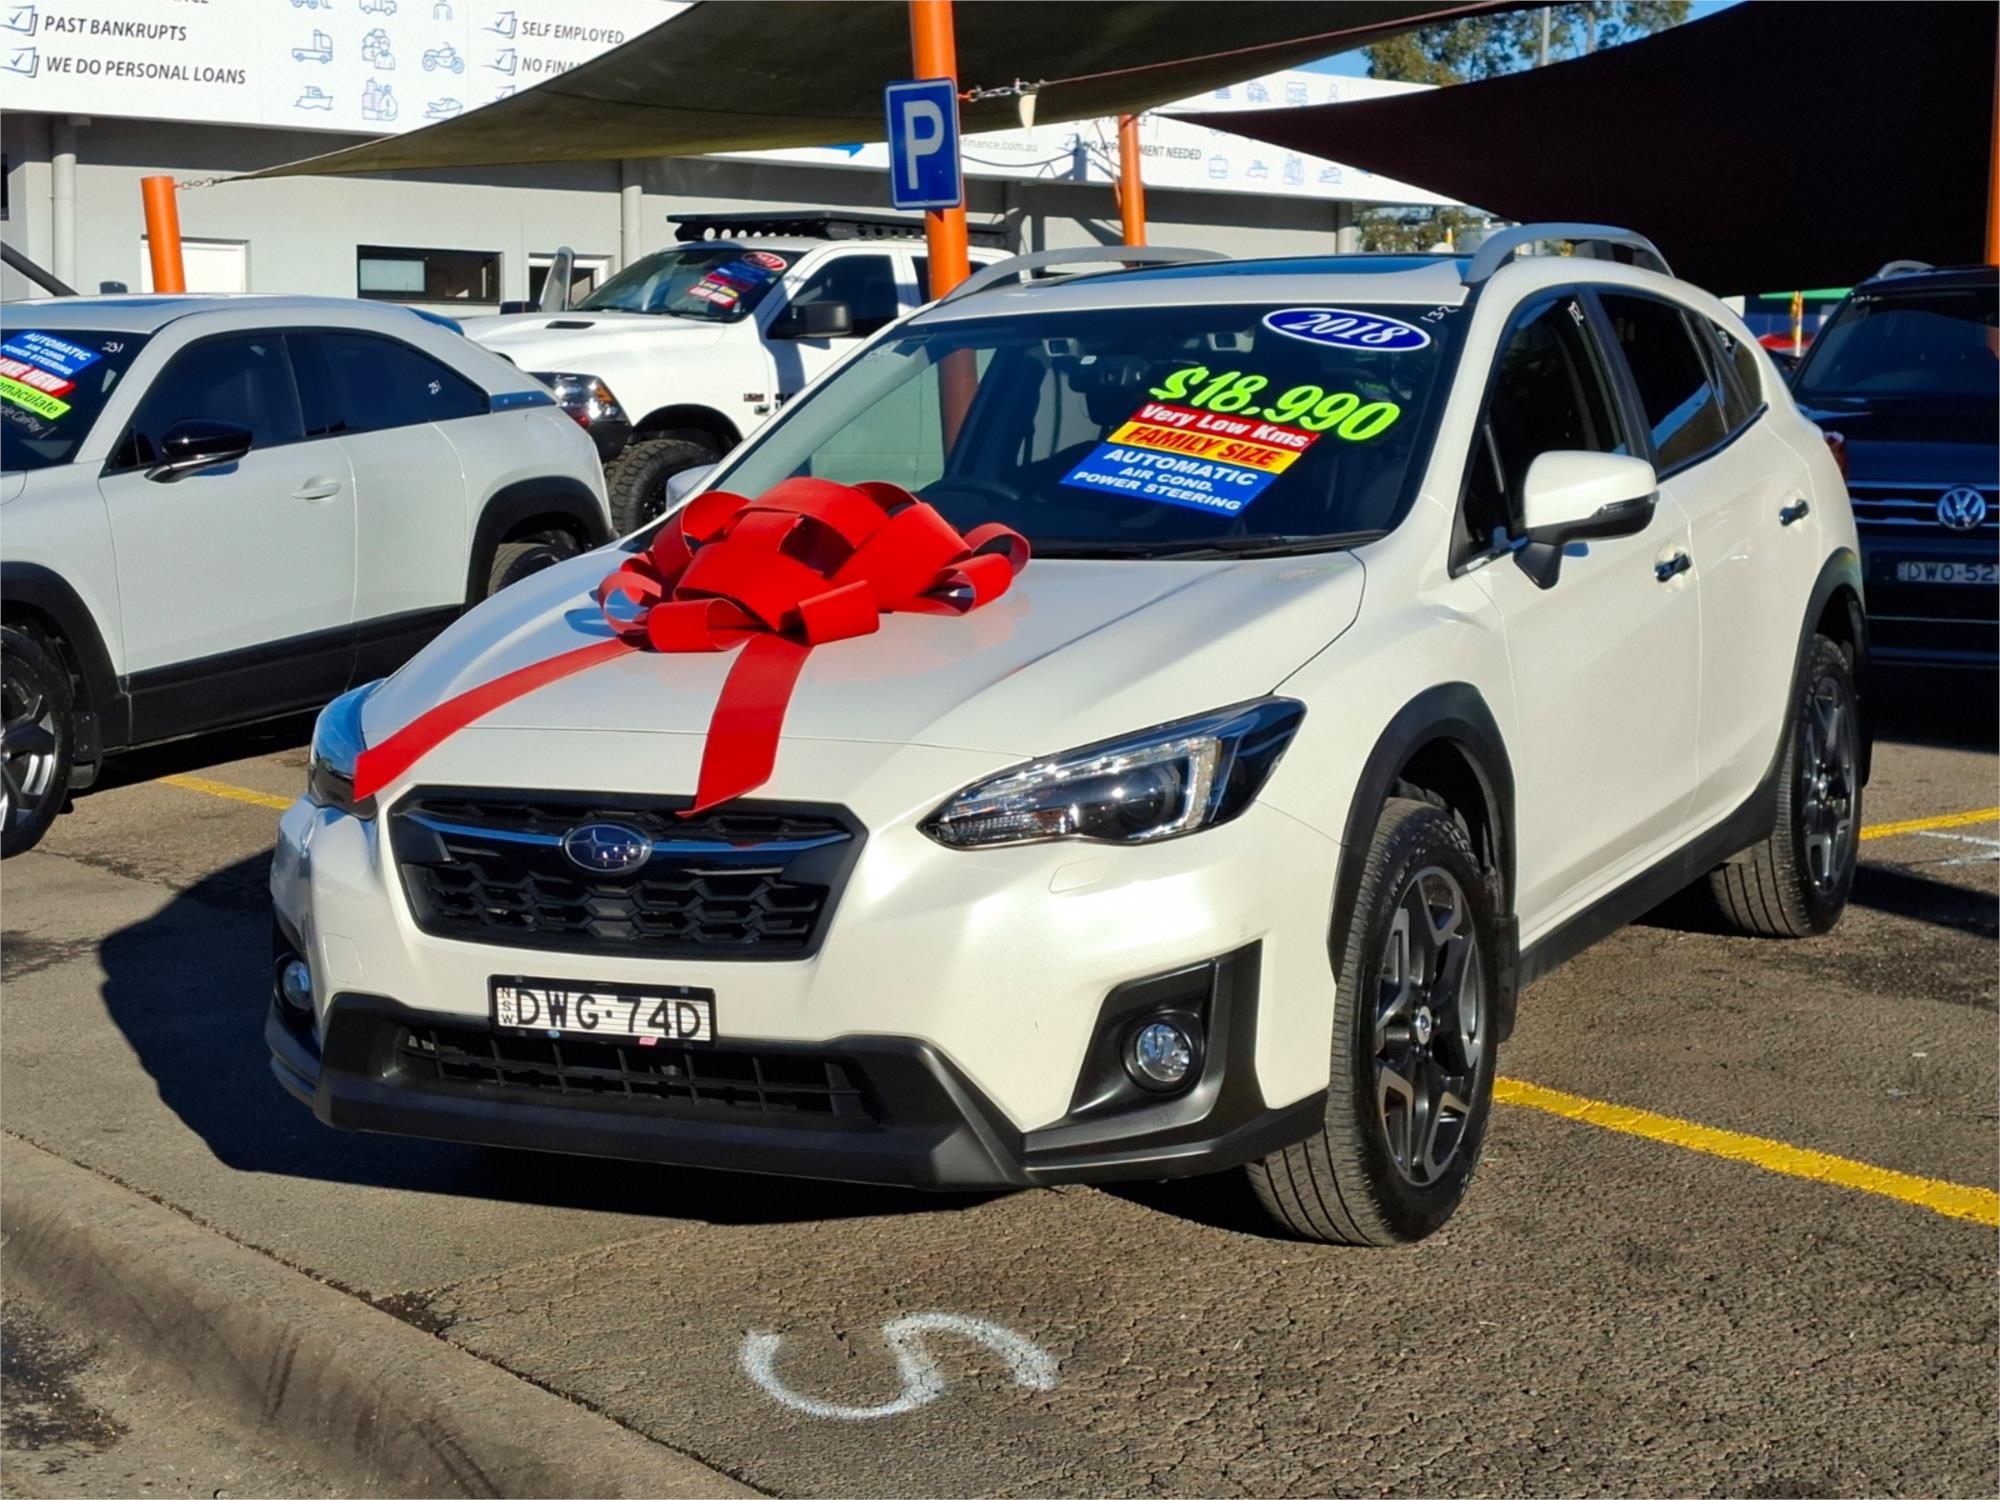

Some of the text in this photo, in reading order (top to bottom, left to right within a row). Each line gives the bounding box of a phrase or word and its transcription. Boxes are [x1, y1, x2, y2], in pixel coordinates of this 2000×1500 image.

[44, 15, 187, 41] PAST BANKRUPTS
[521, 21, 624, 44] SELF EMPLOYED
[46, 56, 246, 85] WE DO PERSONAL LOANS
[522, 57, 581, 74] NO FINA
[904, 100, 943, 190] P
[960, 137, 1038, 152] finance.com.au
[1166, 147, 1202, 160] NEEDED
[1281, 313, 1410, 344] 2018
[23, 333, 92, 361] AUTOMATIC
[1139, 404, 1310, 448] Very Low Kms
[1122, 426, 1286, 469] FAMILY SIZE
[1103, 449, 1258, 486] AUTOMATIC
[1119, 466, 1214, 492] AIR COND.
[1073, 471, 1243, 511] POWER STEERING
